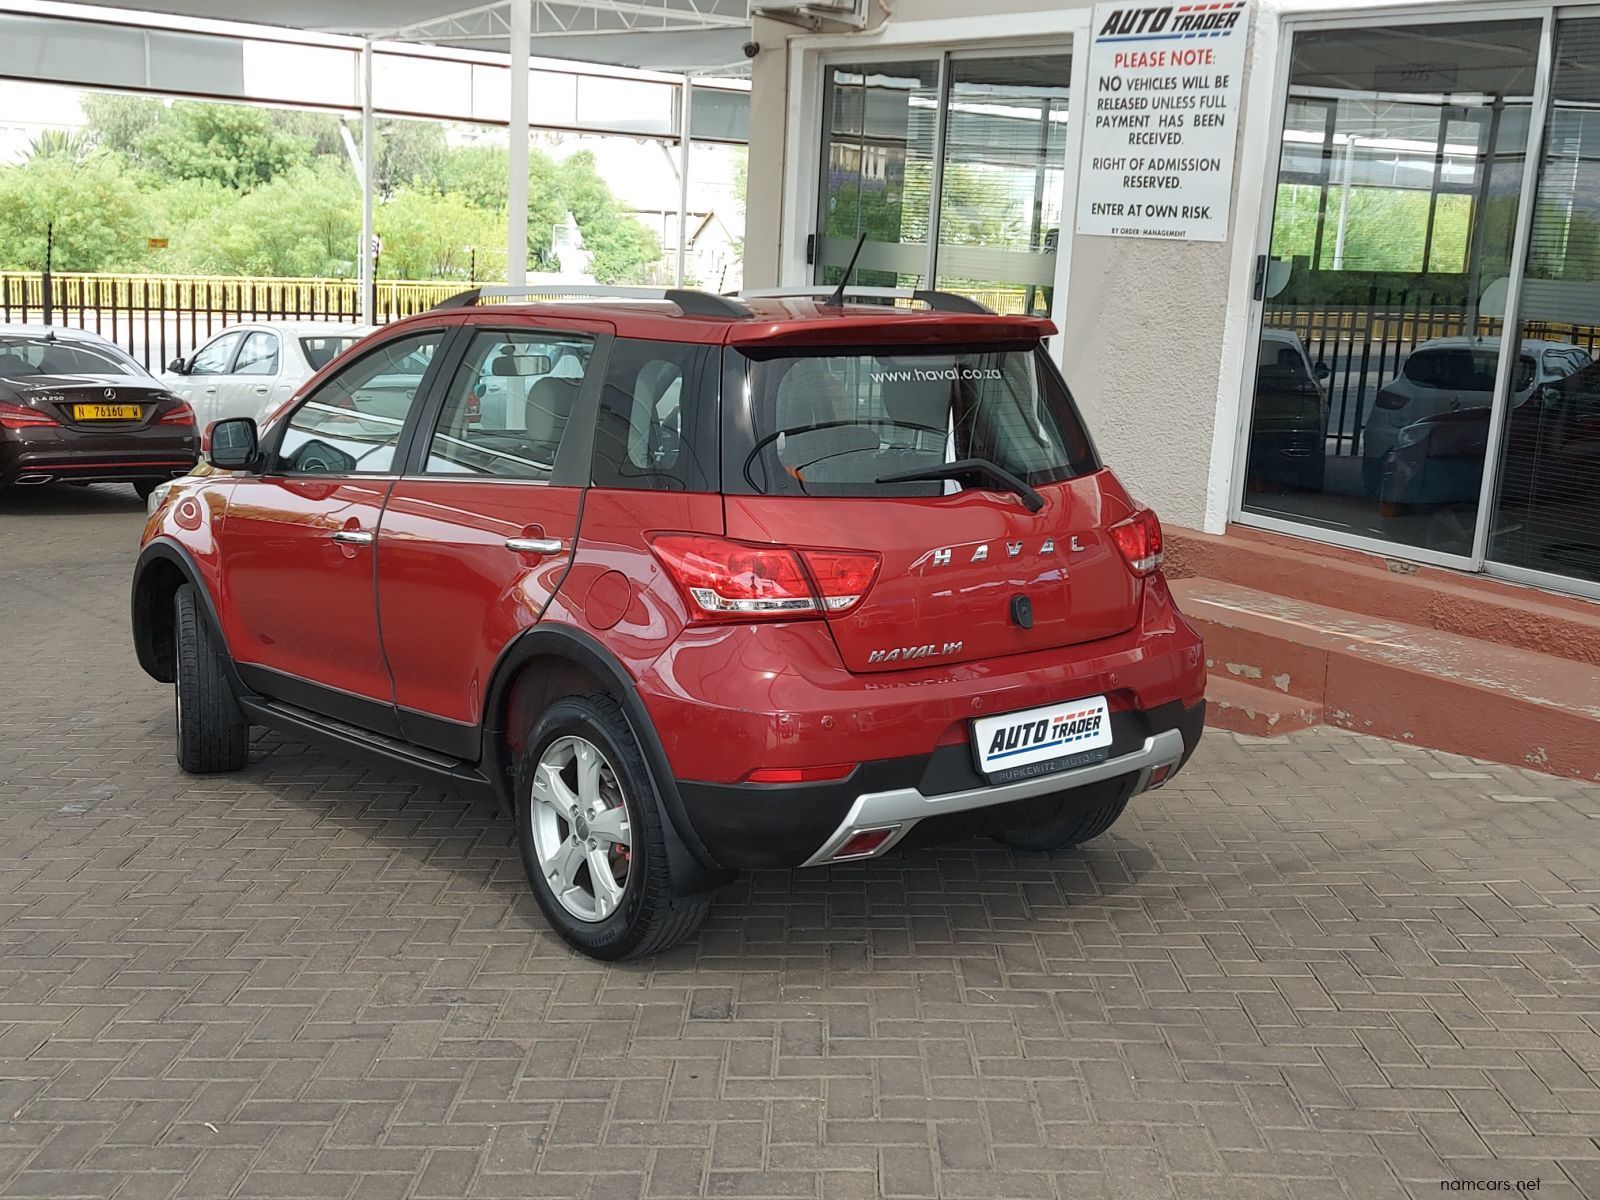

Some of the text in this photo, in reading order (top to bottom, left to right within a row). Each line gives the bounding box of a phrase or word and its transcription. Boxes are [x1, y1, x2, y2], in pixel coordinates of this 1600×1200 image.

[1099, 7, 1241, 36] AUTO TRADER
[1114, 48, 1216, 68] PLEASE NOTE:
[1099, 75, 1229, 92] NO VEHICLES WILL BE
[1097, 95, 1227, 111] RELEASED UNLESS FULL
[1095, 114, 1225, 129] PAYMENT HAS BEEN
[1128, 132, 1184, 145] RECEIVED.
[1092, 157, 1221, 171] RIGHT OF ADMISSION
[1123, 176, 1182, 189] RESERVED.
[1091, 203, 1213, 220] ENTER AT OWN RISK.
[1143, 229, 1186, 238] MANAGEMENT
[870, 367, 1002, 383] www.haval.co.za
[78, 406, 138, 418] N 76160 W
[933, 536, 1085, 566] HAVAL
[867, 640, 964, 663] HAVAL H1
[988, 715, 1103, 755] AUTO TRADER
[998, 762, 1056, 781] PUPKEWITZ
